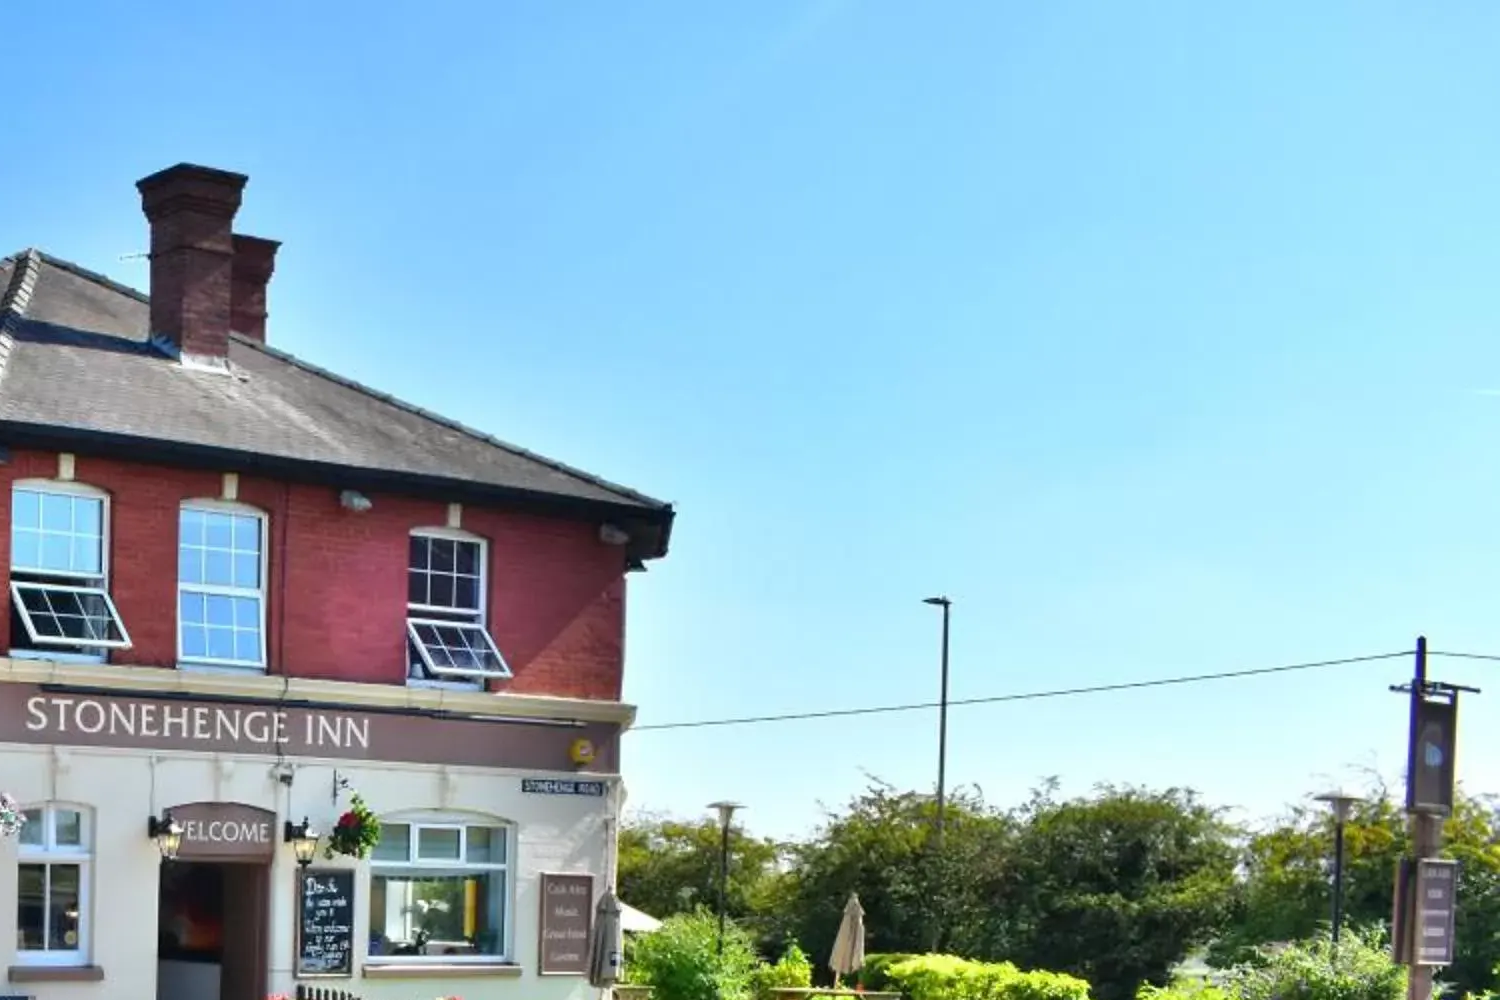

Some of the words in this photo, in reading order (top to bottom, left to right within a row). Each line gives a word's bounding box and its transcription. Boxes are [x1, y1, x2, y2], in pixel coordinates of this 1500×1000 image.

[25, 696, 290, 744] STONEHENGE
[304, 714, 370, 749] INN
[180, 820, 270, 843] ELCOME
